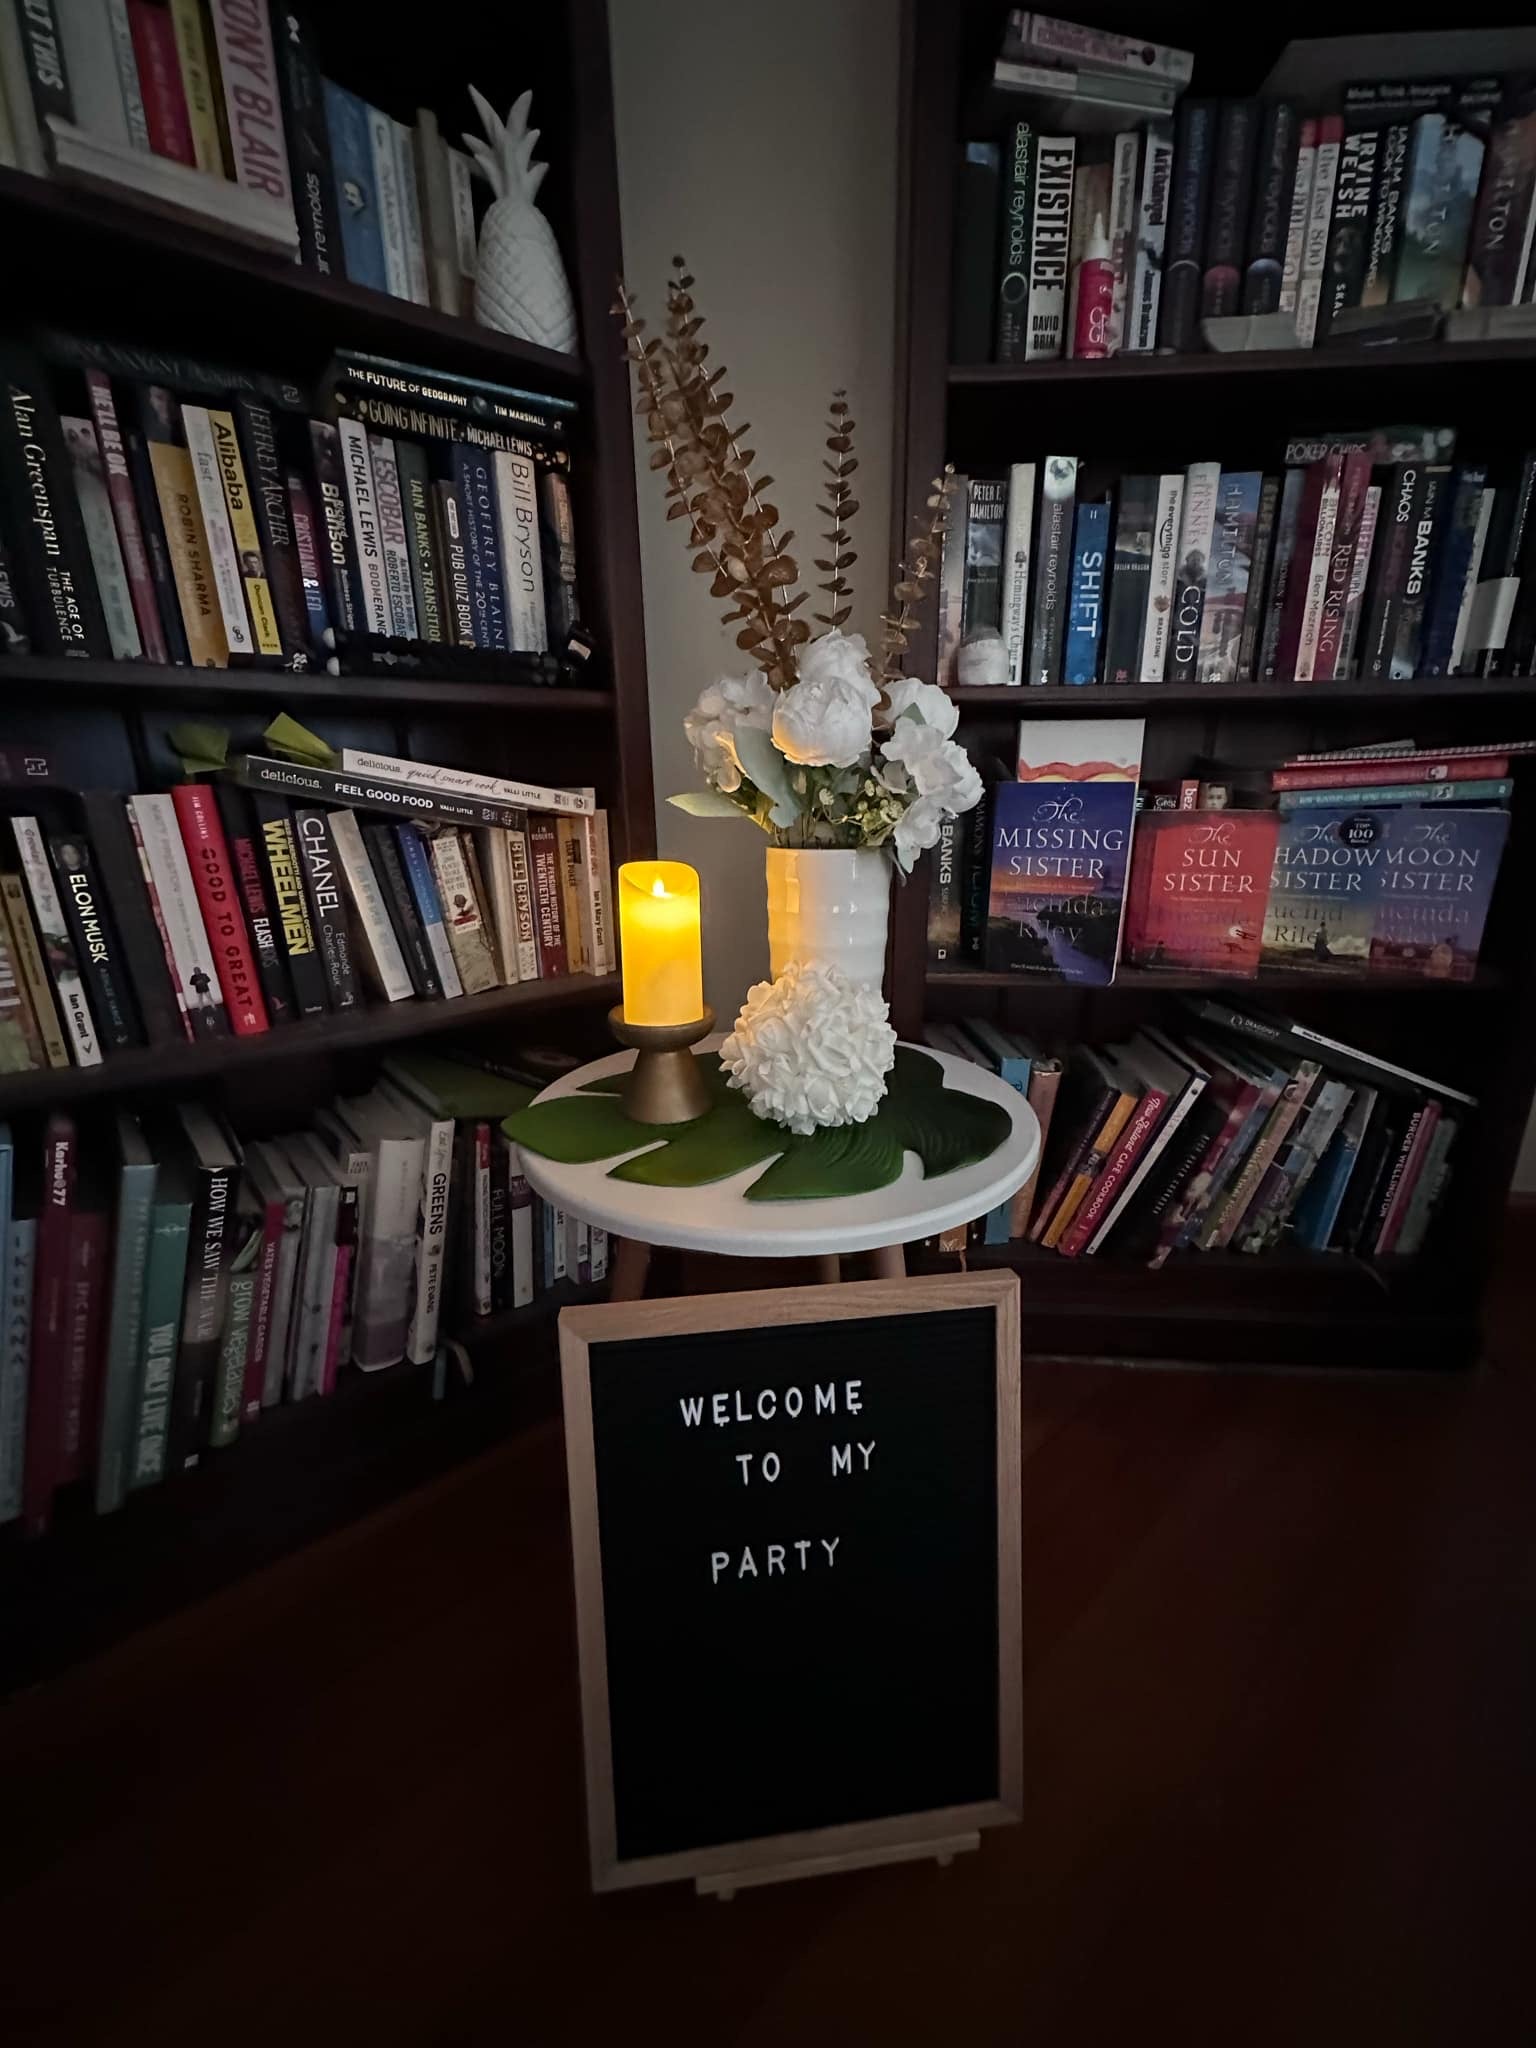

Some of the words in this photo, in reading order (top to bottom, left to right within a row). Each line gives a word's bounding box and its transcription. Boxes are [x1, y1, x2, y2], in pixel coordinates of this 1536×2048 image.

[232, 84, 284, 200] BLAIR
[1014, 121, 1031, 184] alastair
[1143, 147, 1172, 227] Arkhangel
[1335, 135, 1361, 218] WELSH
[1351, 131, 1379, 218] IRVINE
[1008, 189, 1026, 265] reynolds
[1032, 149, 1073, 291] EXISTENCE
[1381, 190, 1400, 254] BANKS
[1308, 227, 1323, 266] 800
[1142, 270, 1160, 301] James
[1032, 315, 1059, 331] DAVID
[347, 367, 366, 381] THE
[365, 371, 408, 394] FUTURE
[408, 383, 420, 394] OF
[421, 386, 469, 408] GEOGRAPHY
[494, 404, 508, 418] TIM
[508, 407, 548, 428] MARSHALL
[100, 428, 124, 452] BE
[367, 399, 410, 431] GOING
[408, 407, 460, 443] INFINITE
[466, 424, 508, 451] MICHAEL
[506, 432, 534, 458] LEWIS
[7, 384, 36, 438] Alan
[23, 443, 61, 556] Greenspan
[105, 452, 130, 478] OK
[213, 421, 244, 511] Alibaba
[240, 398, 280, 476] JEFFREY
[260, 476, 291, 546] ARCHER
[348, 435, 371, 506] MICHAEL
[1285, 443, 1328, 463] POKER
[374, 456, 405, 545] ESCOBAR
[409, 479, 426, 509] IAIN
[511, 461, 532, 502] Bill
[973, 484, 994, 499] PETER
[1169, 490, 1178, 504] the
[1395, 469, 1417, 524] CHAOS
[320, 482, 347, 565] Branson
[475, 466, 498, 573] GEOFFREY
[969, 503, 1005, 520] HAMILTON
[1049, 502, 1065, 552] alastair
[1192, 474, 1208, 546] FIENNES
[1314, 498, 1328, 558] BILLIONAIRES
[359, 510, 378, 558] LEWIS
[414, 511, 433, 559] BANKS
[513, 506, 535, 593] Bryson
[1163, 505, 1176, 560] everything
[1216, 483, 1243, 588] HAMILTON
[176, 493, 198, 545] ROBIN
[187, 550, 212, 616] SHARMA
[386, 549, 402, 593] ROBERTO
[448, 544, 466, 570] PUB
[1159, 561, 1170, 587] store
[1329, 543, 1353, 583] RED
[1406, 520, 1433, 597] BANKS
[60, 570, 74, 593] THE
[302, 577, 320, 589] &
[367, 563, 387, 636] BOOMERANG
[453, 573, 470, 602] QUIZ
[1008, 568, 1028, 633] Hemingway's
[1046, 553, 1060, 612] reynolds
[1075, 550, 1103, 640] SHIFT
[1313, 574, 1324, 598] Ben
[46, 566, 73, 642] TURBULENCE
[65, 595, 81, 621] AGE
[456, 603, 473, 637] BOOK
[1174, 585, 1201, 663] COLD
[1304, 600, 1322, 647] Mezrich
[1319, 587, 1346, 653] RISING
[71, 623, 86, 641] OF
[334, 782, 365, 797] FEEL
[365, 788, 401, 804] GOOD
[402, 795, 434, 810] FOOD
[456, 806, 474, 816] LITTLE
[521, 790, 542, 800] LITTLE
[1031, 796, 1084, 824] The
[1154, 793, 1177, 809] Greg
[194, 810, 209, 840] COLLINS
[997, 827, 1125, 851] MISSING
[1188, 822, 1237, 846] The
[1294, 821, 1341, 844] The
[1348, 828, 1374, 842] 100
[1354, 822, 1372, 831] TOP
[1413, 821, 1456, 844] The
[302, 817, 340, 918] CHANEL
[510, 842, 526, 879] BILL
[938, 823, 955, 884] BANKS
[1008, 855, 1105, 880] SISTER
[1181, 848, 1241, 869] SUN
[201, 847, 228, 903] GOOD
[262, 818, 310, 957] WHEELMEN
[535, 852, 552, 905] TWENTIETH
[545, 852, 555, 866] THE
[550, 896, 560, 924] HISTORY
[1162, 872, 1254, 894] SISTER
[1269, 871, 1363, 892] SISTER
[68, 873, 94, 922] ELON
[82, 920, 109, 965] MUSK
[217, 911, 235, 938] TO
[514, 884, 533, 943] BRYSON
[540, 906, 556, 948] CENTURY
[335, 931, 350, 976] Edmonde
[224, 944, 254, 1009] GREAT
[69, 992, 80, 1011] Ian
[73, 1011, 90, 1040] Grant
[1147, 1096, 1162, 1120] New
[1123, 1119, 1151, 1154] Zealand
[1404, 1111, 1423, 1149] BURGER
[1111, 1151, 1130, 1176] CAFE
[1378, 1149, 1411, 1219] WELLINGTON
[208, 1177, 230, 1214] HOW
[429, 1172, 448, 1236] GREENS
[490, 1187, 505, 1223] FULL
[1085, 1172, 1117, 1220] COOKBOOK
[206, 1216, 227, 1241] WE
[203, 1242, 224, 1273] SAW
[264, 1241, 276, 1270] YATES
[491, 1225, 508, 1279] MOON
[201, 1276, 220, 1305] THE
[427, 1263, 438, 1286] PETE
[230, 1279, 255, 1321] grow
[257, 1272, 273, 1323] VEGETABLE
[148, 1321, 176, 1358] YOU
[253, 1324, 268, 1363] GARDEN
[145, 1358, 174, 1395] ONLY
[140, 1401, 171, 1435] LIVE
[678, 1379, 864, 1428] WELCOME
[136, 1436, 168, 1479] ONCE
[734, 1450, 782, 1487] TO
[830, 1440, 877, 1478] MY
[710, 1535, 841, 1595] PARTY
